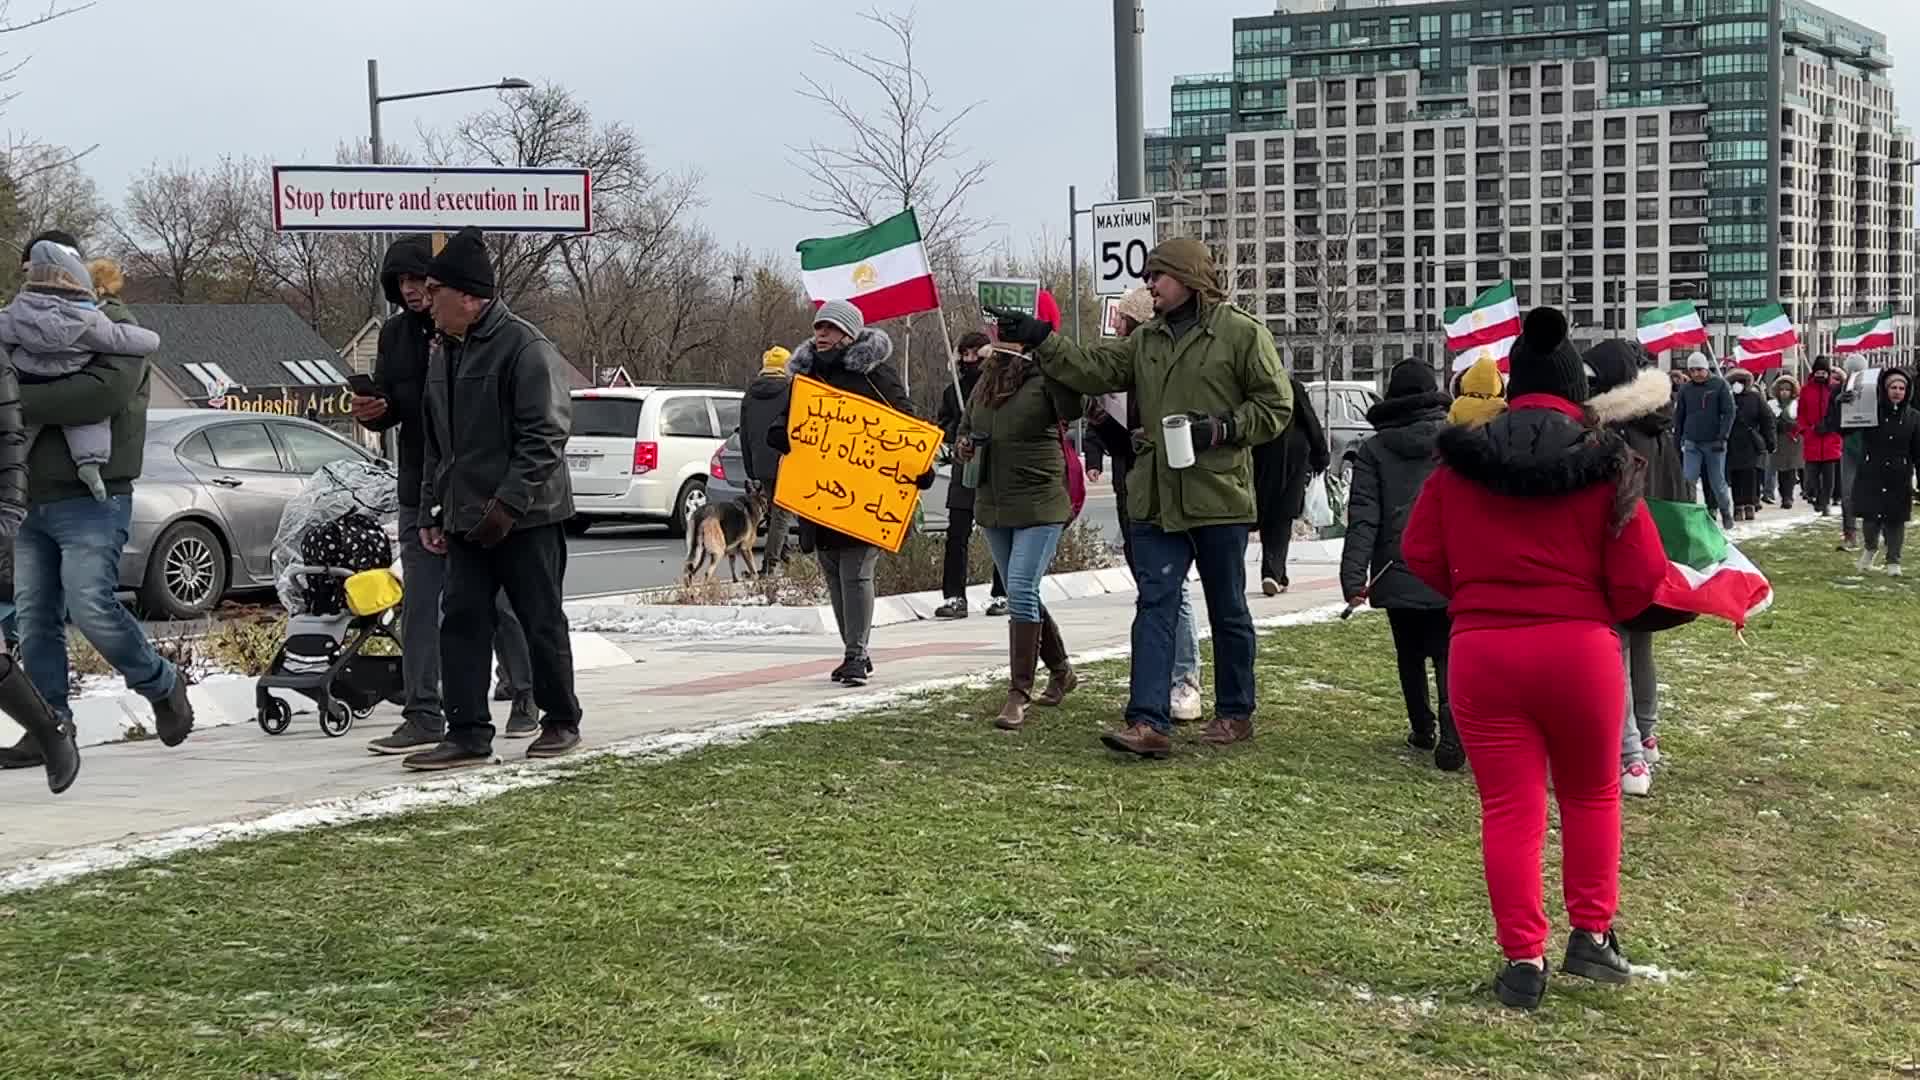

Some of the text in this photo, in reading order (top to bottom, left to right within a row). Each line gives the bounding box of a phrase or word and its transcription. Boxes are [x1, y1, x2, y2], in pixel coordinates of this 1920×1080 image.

[284, 185, 580, 217] Stop torture and execution in Iran
[1096, 212, 1151, 229] MAXIMUM
[1102, 239, 1148, 280] 50
[981, 286, 1033, 305] RISE
[224, 393, 299, 416] Dadashi
[306, 393, 333, 414] Art
[838, 436, 875, 470] شاه
[803, 480, 855, 511] رهبر
